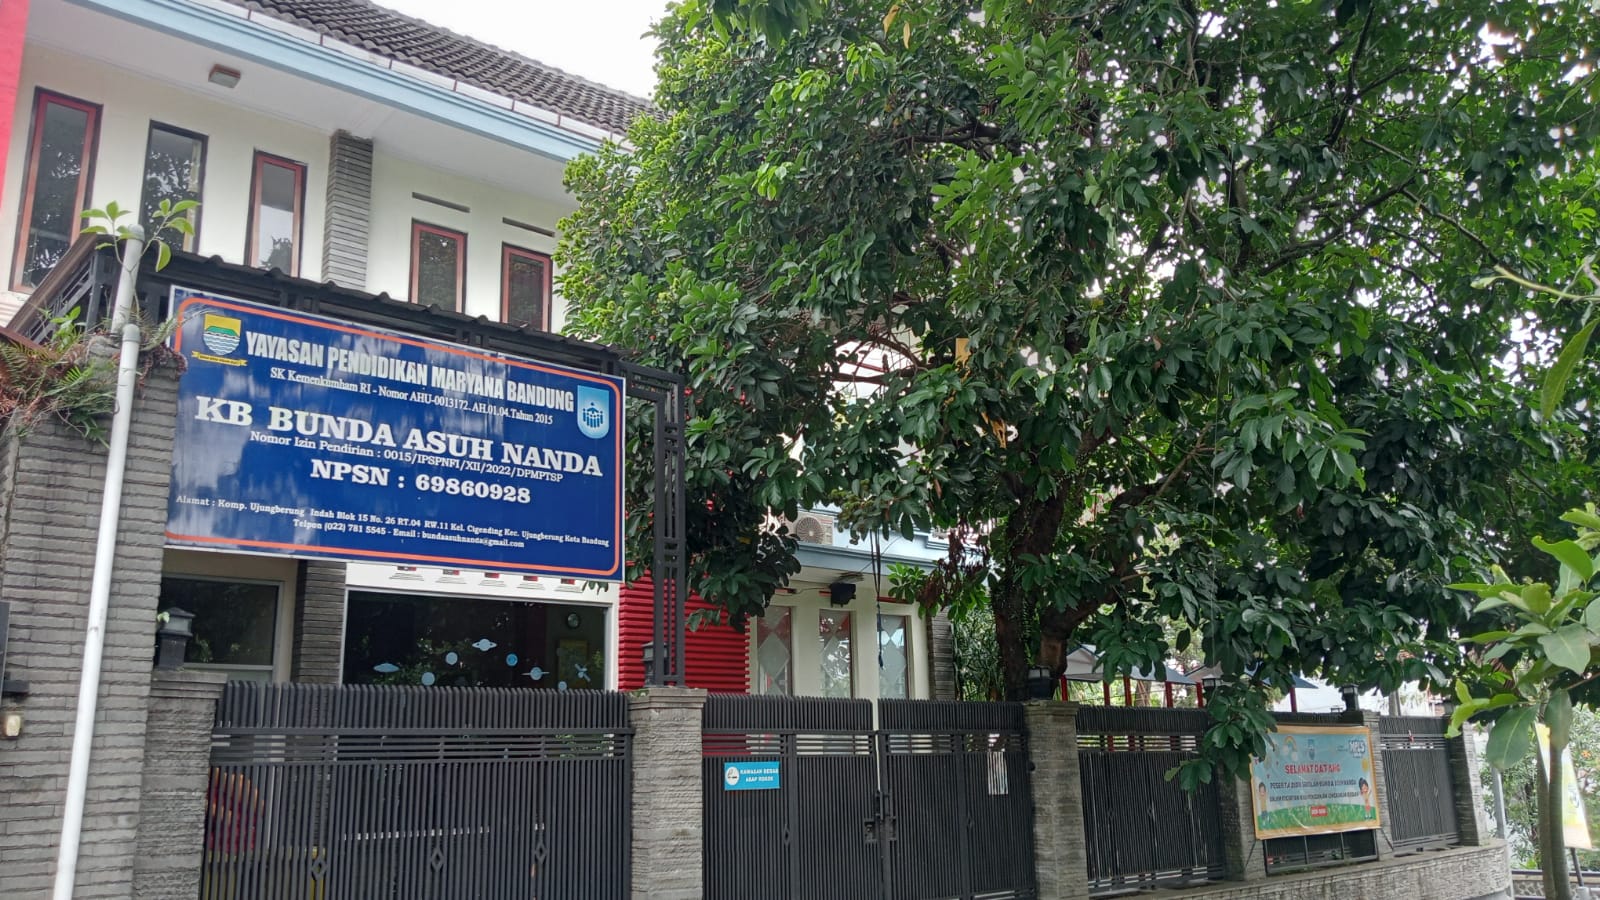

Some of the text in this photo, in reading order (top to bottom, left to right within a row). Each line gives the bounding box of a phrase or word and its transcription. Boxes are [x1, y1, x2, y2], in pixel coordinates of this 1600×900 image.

[246, 331, 574, 412] YAYASAN PENDIDIKAN MARYANA BANDUNG
[270, 367, 285, 380] SK
[287, 369, 358, 392] Kemenkumham
[360, 382, 371, 394] RI
[378, 383, 408, 399] Nomor
[409, 391, 471, 411] AHU-0013172.
[535, 412, 553, 425] 2015
[194, 395, 603, 477] KB BUNDA ASUH NANDA
[250, 431, 563, 483] Nomor Izin Pendirian : 0015/IPSPNFI/XII/2022/DPMPTSP
[310, 458, 531, 504] NPSN : 69860928
[176, 495, 210, 506] Alamat
[218, 499, 247, 511] Komp.
[250, 502, 305, 517] Ujungberung
[310, 508, 335, 519] Indah
[336, 511, 356, 521] Blok
[358, 513, 368, 522] 15
[370, 515, 382, 524] No.
[385, 516, 396, 526] 26
[397, 517, 421, 527] RT.04
[424, 520, 449, 530] RW.11
[451, 522, 465, 532] Kel.
[467, 524, 503, 537] Cigending
[504, 527, 520, 537] Kec.
[522, 530, 563, 544] Ujungberung
[565, 535, 580, 544] Kota
[582, 536, 610, 548] Bandung
[293, 518, 322, 531] Telpon
[324, 521, 346, 533] (022)
[348, 524, 363, 534] 781
[365, 525, 386, 536] 5545
[393, 528, 416, 538] Email
